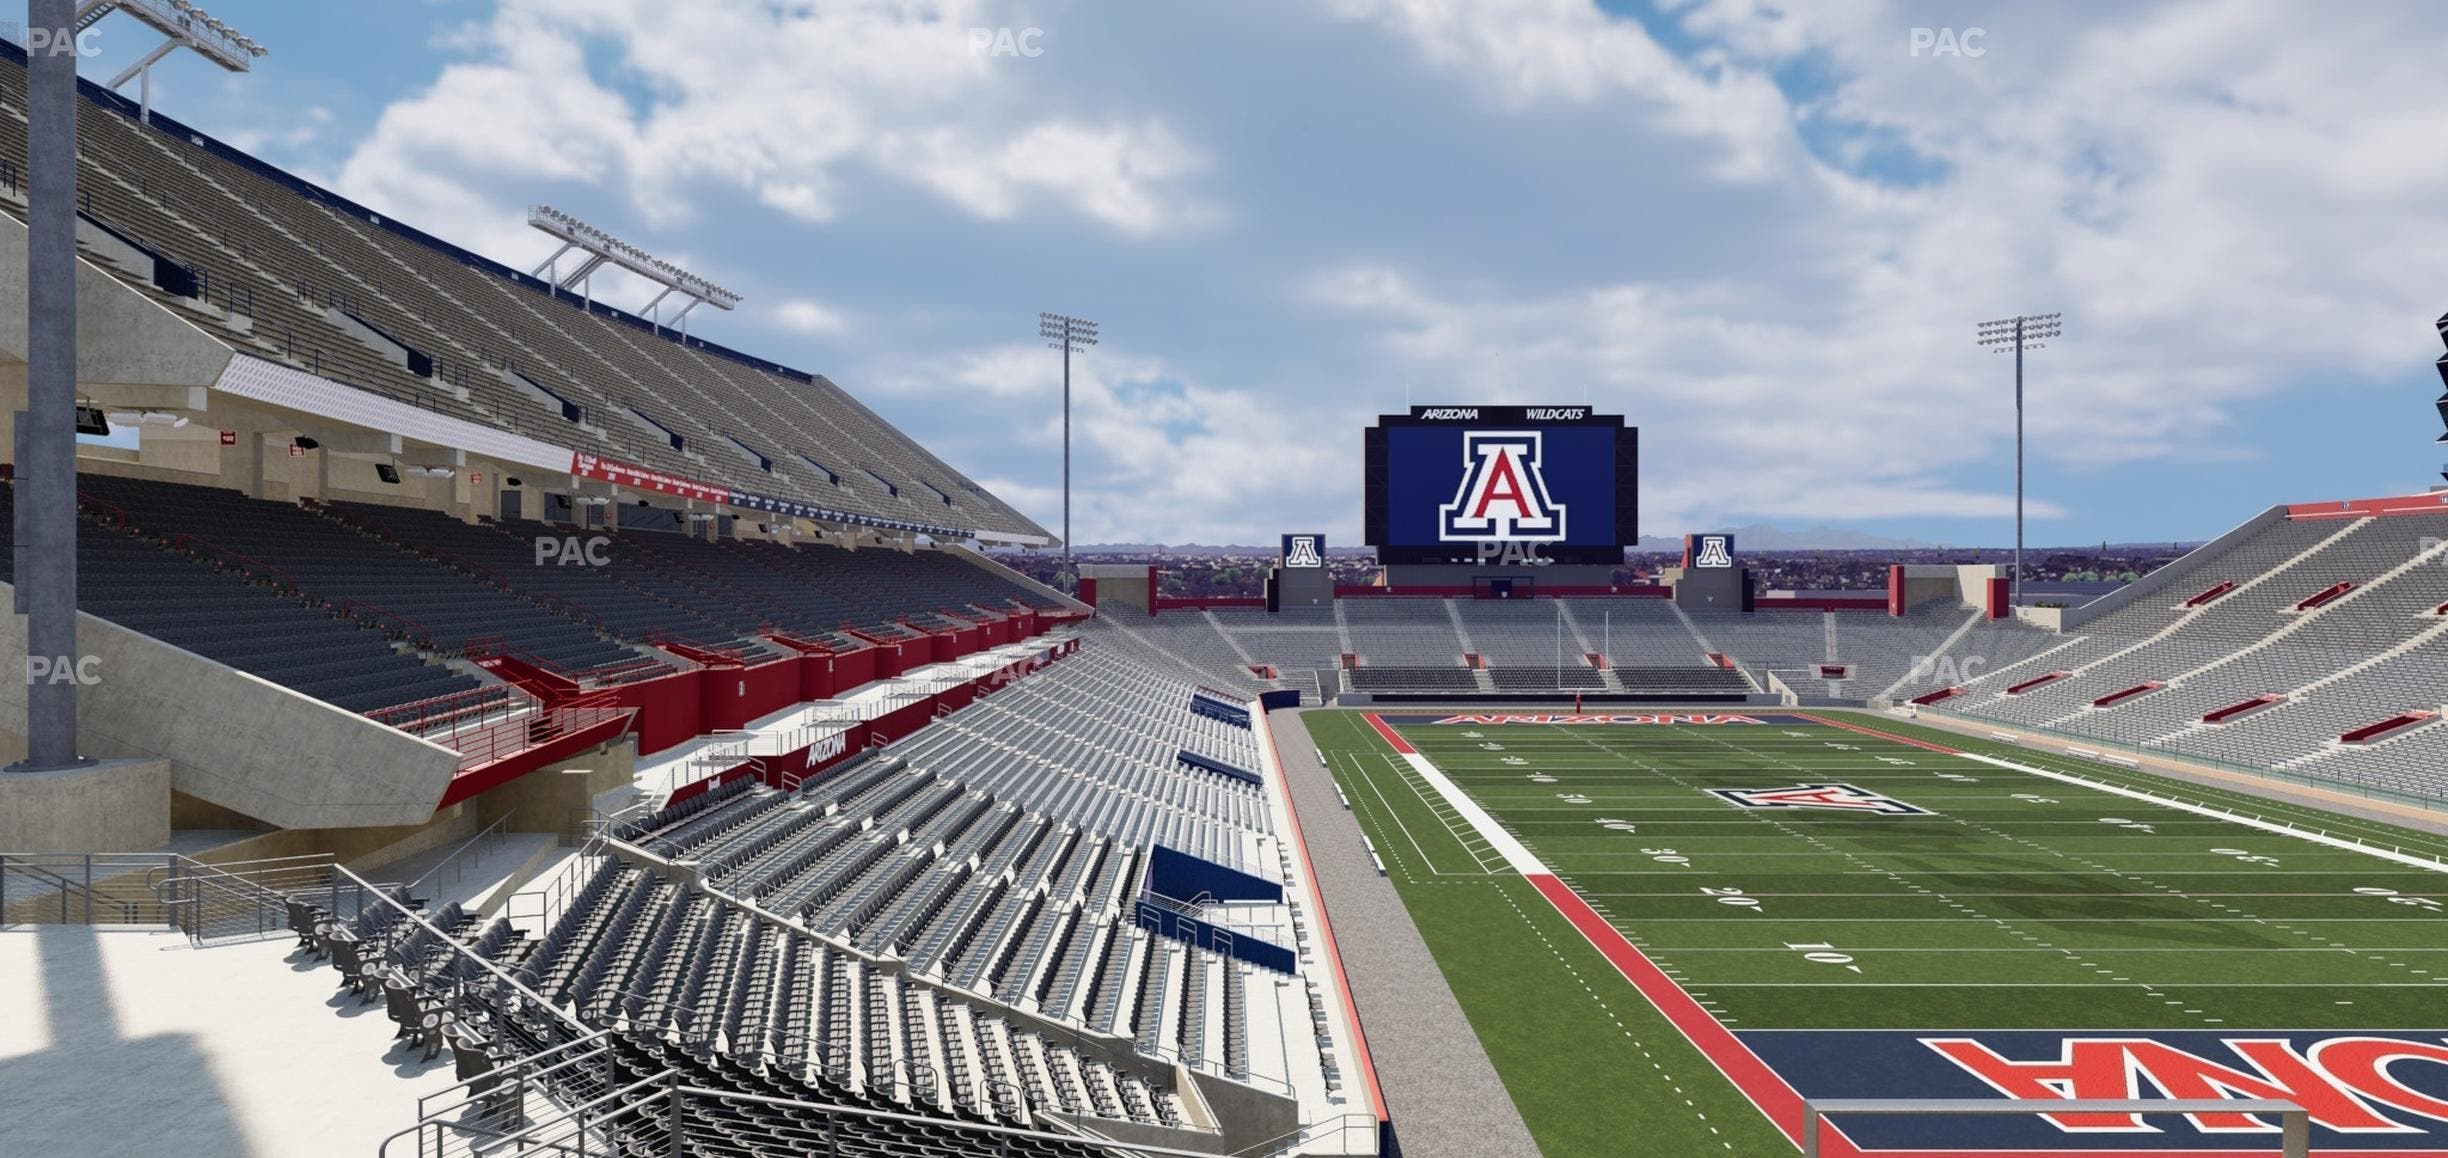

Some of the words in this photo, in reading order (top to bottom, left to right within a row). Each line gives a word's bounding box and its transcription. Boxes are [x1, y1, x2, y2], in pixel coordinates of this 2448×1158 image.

[1421, 408, 1479, 420] ARIZONA
[1525, 408, 1585, 420] WILDCATS
[1439, 431, 1566, 541] A
[1432, 714, 1767, 724] ARIZONA
[806, 731, 846, 769] ARIZONA
[1699, 887, 1759, 906] 20
[1783, 941, 1854, 963] 10
